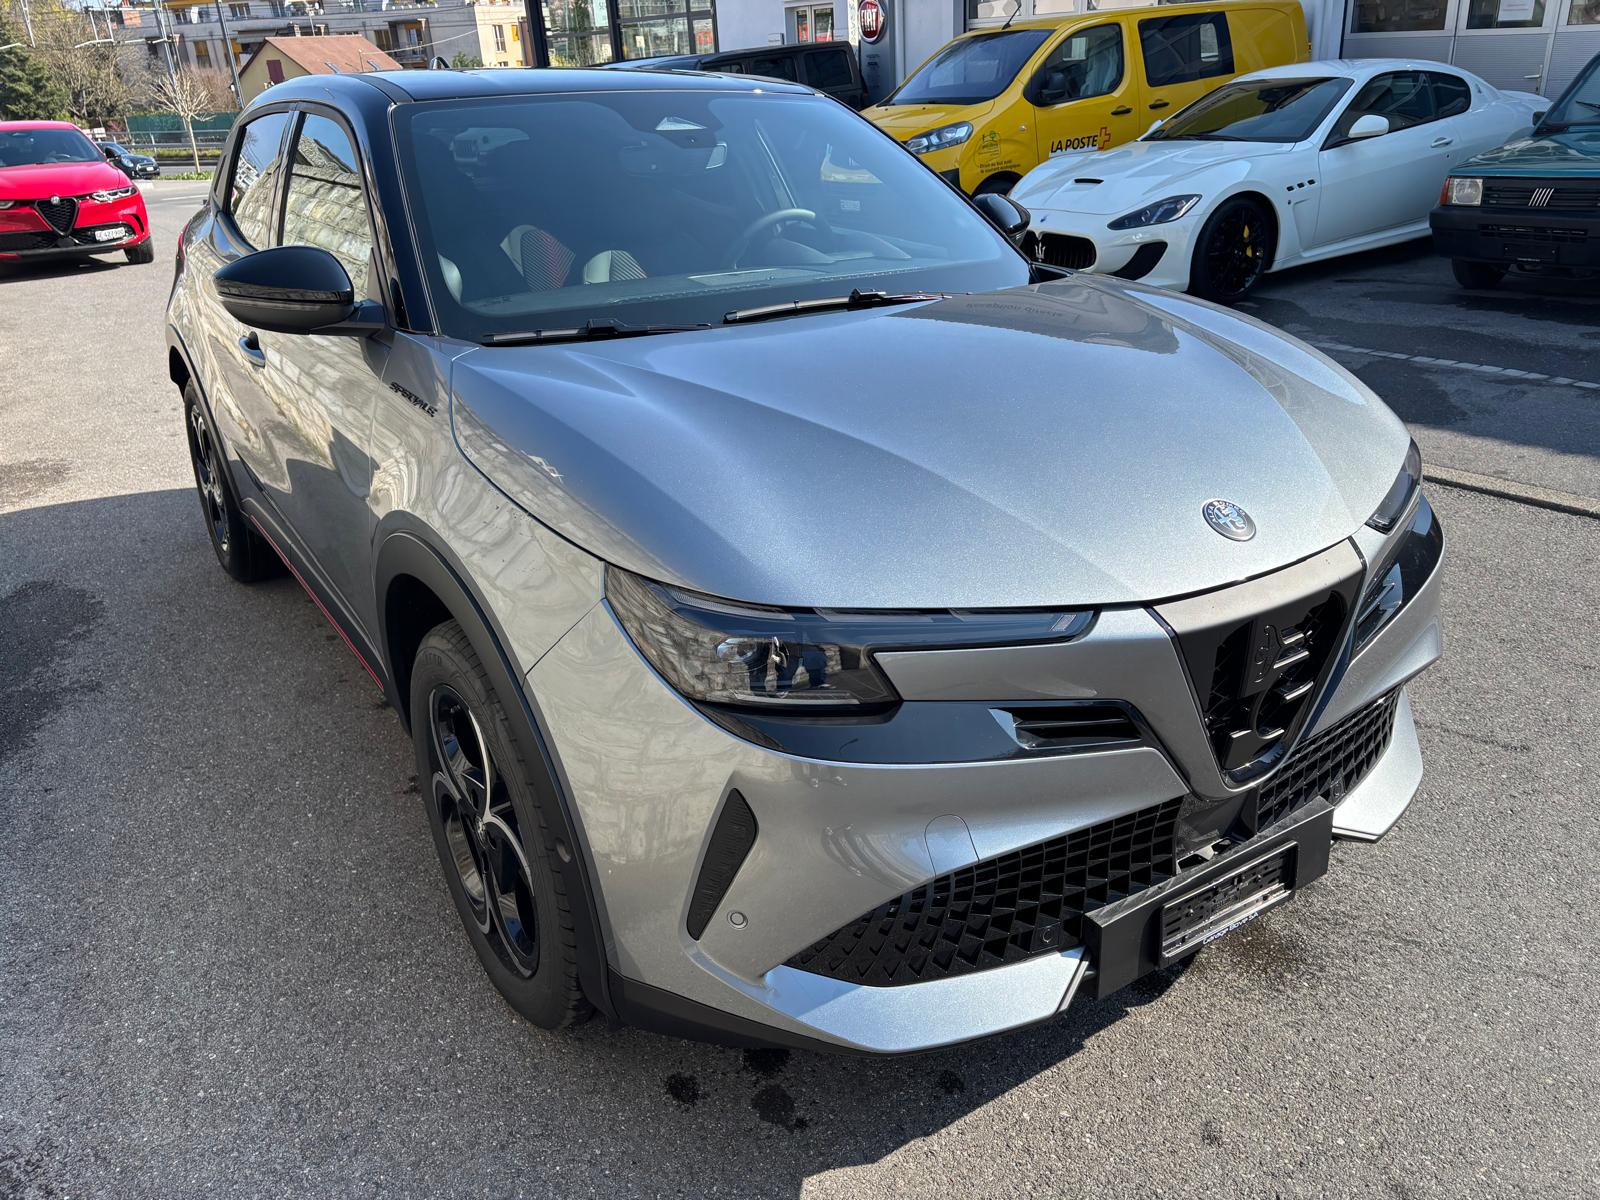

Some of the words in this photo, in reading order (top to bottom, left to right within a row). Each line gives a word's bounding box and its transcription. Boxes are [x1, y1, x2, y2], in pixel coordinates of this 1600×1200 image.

[861, 9, 877, 31] FIAT
[1051, 140, 1063, 153] LA
[1065, 135, 1098, 151] POSTE
[389, 381, 438, 418] SPECIALE
[1203, 927, 1229, 944] Garage
[1248, 911, 1259, 921] SA
